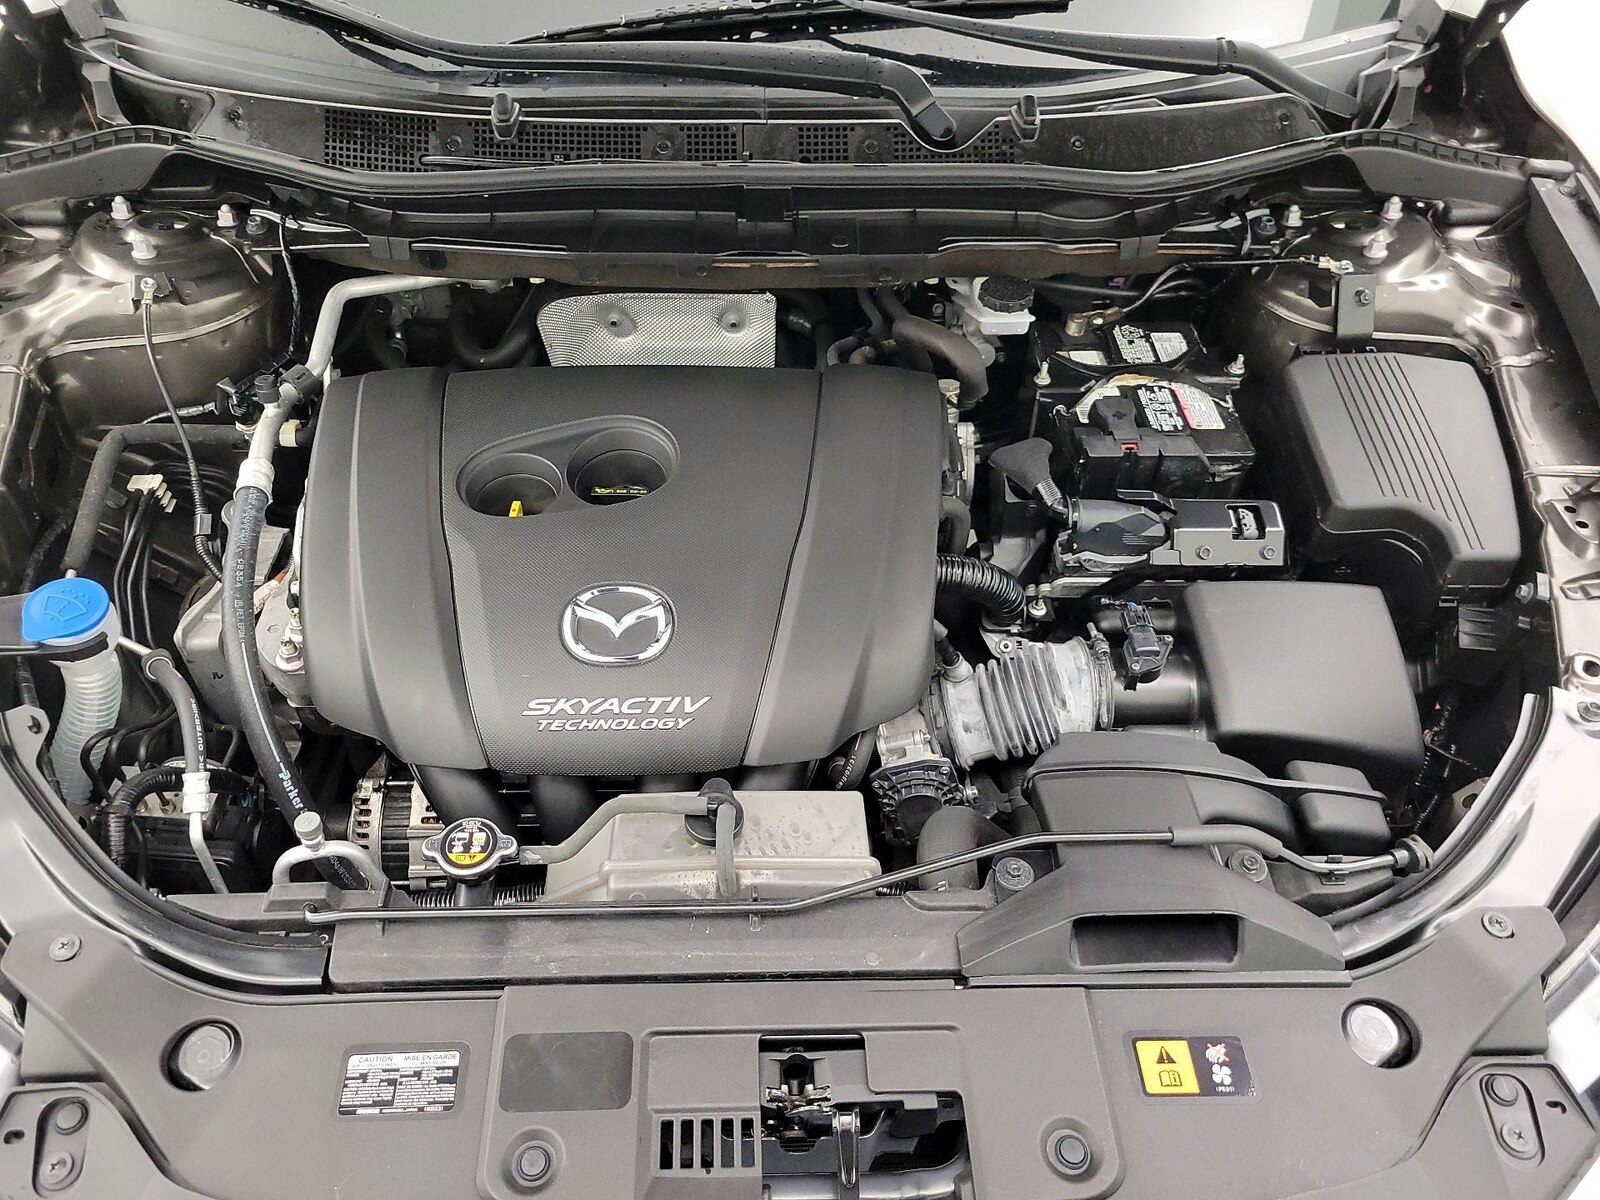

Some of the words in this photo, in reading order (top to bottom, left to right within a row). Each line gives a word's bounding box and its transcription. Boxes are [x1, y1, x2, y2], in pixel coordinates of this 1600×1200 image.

[521, 696, 713, 716] SKYACTIV
[536, 717, 696, 731] TECHNOLOGY
[278, 769, 304, 809] Parker
